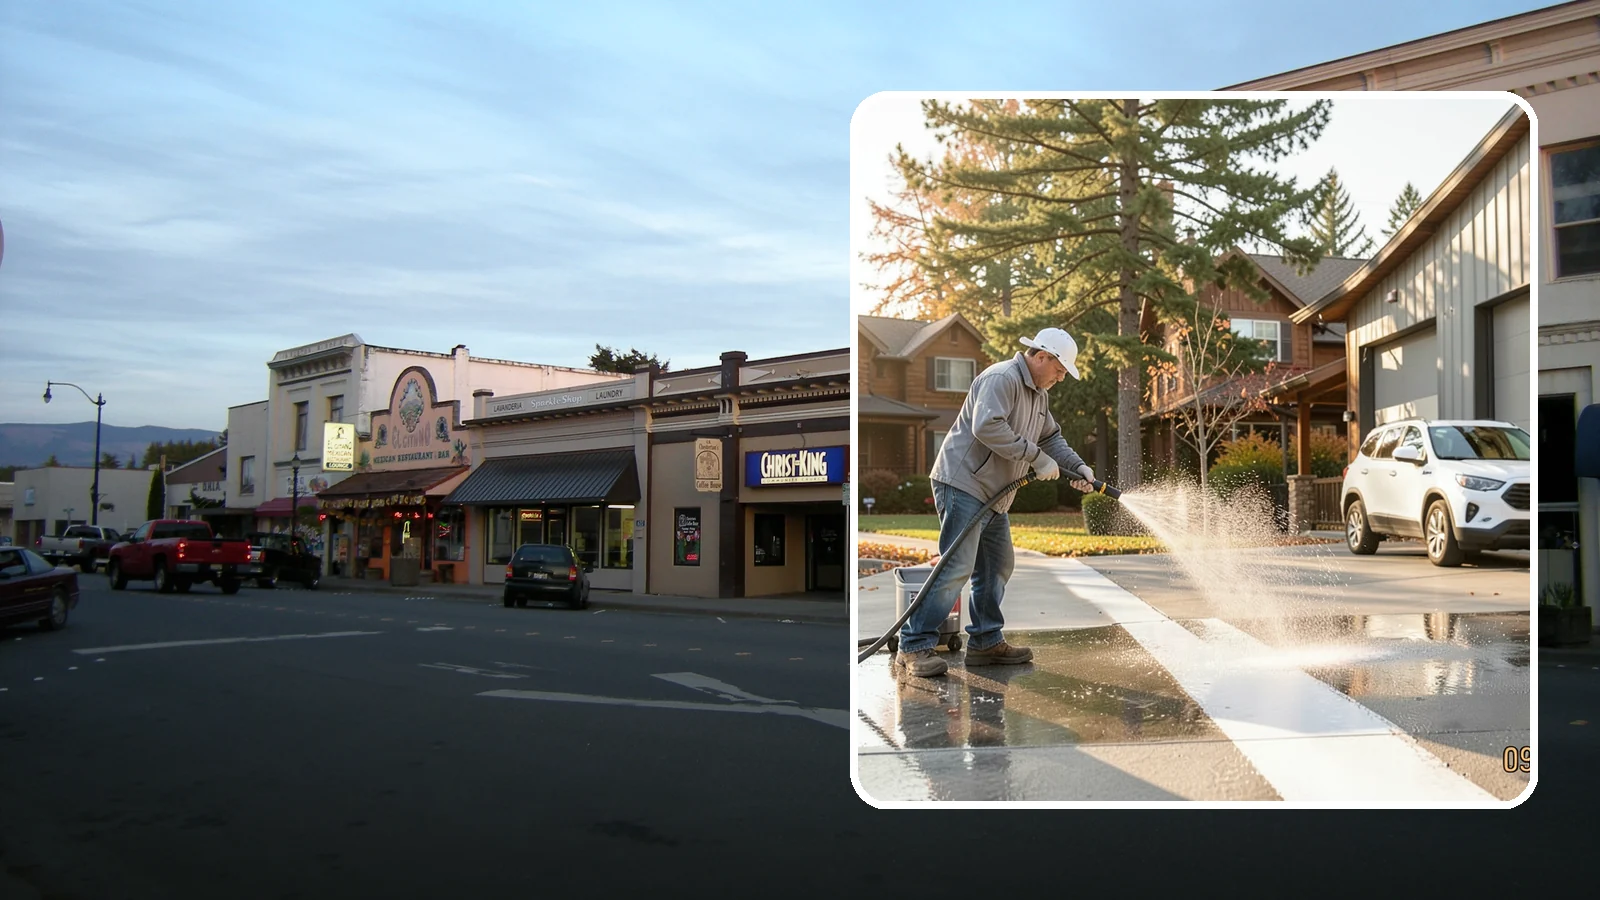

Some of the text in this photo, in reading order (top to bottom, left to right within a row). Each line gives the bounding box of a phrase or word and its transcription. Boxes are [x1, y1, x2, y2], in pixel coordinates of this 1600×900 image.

[595, 388, 624, 400] LAUNDRY
[493, 402, 523, 412] LAVANDERIA
[530, 394, 582, 409] Sparkle Shop
[374, 450, 450, 464] MEXICAN RESTAURANT BAR
[760, 450, 827, 478] CHRIST KING
